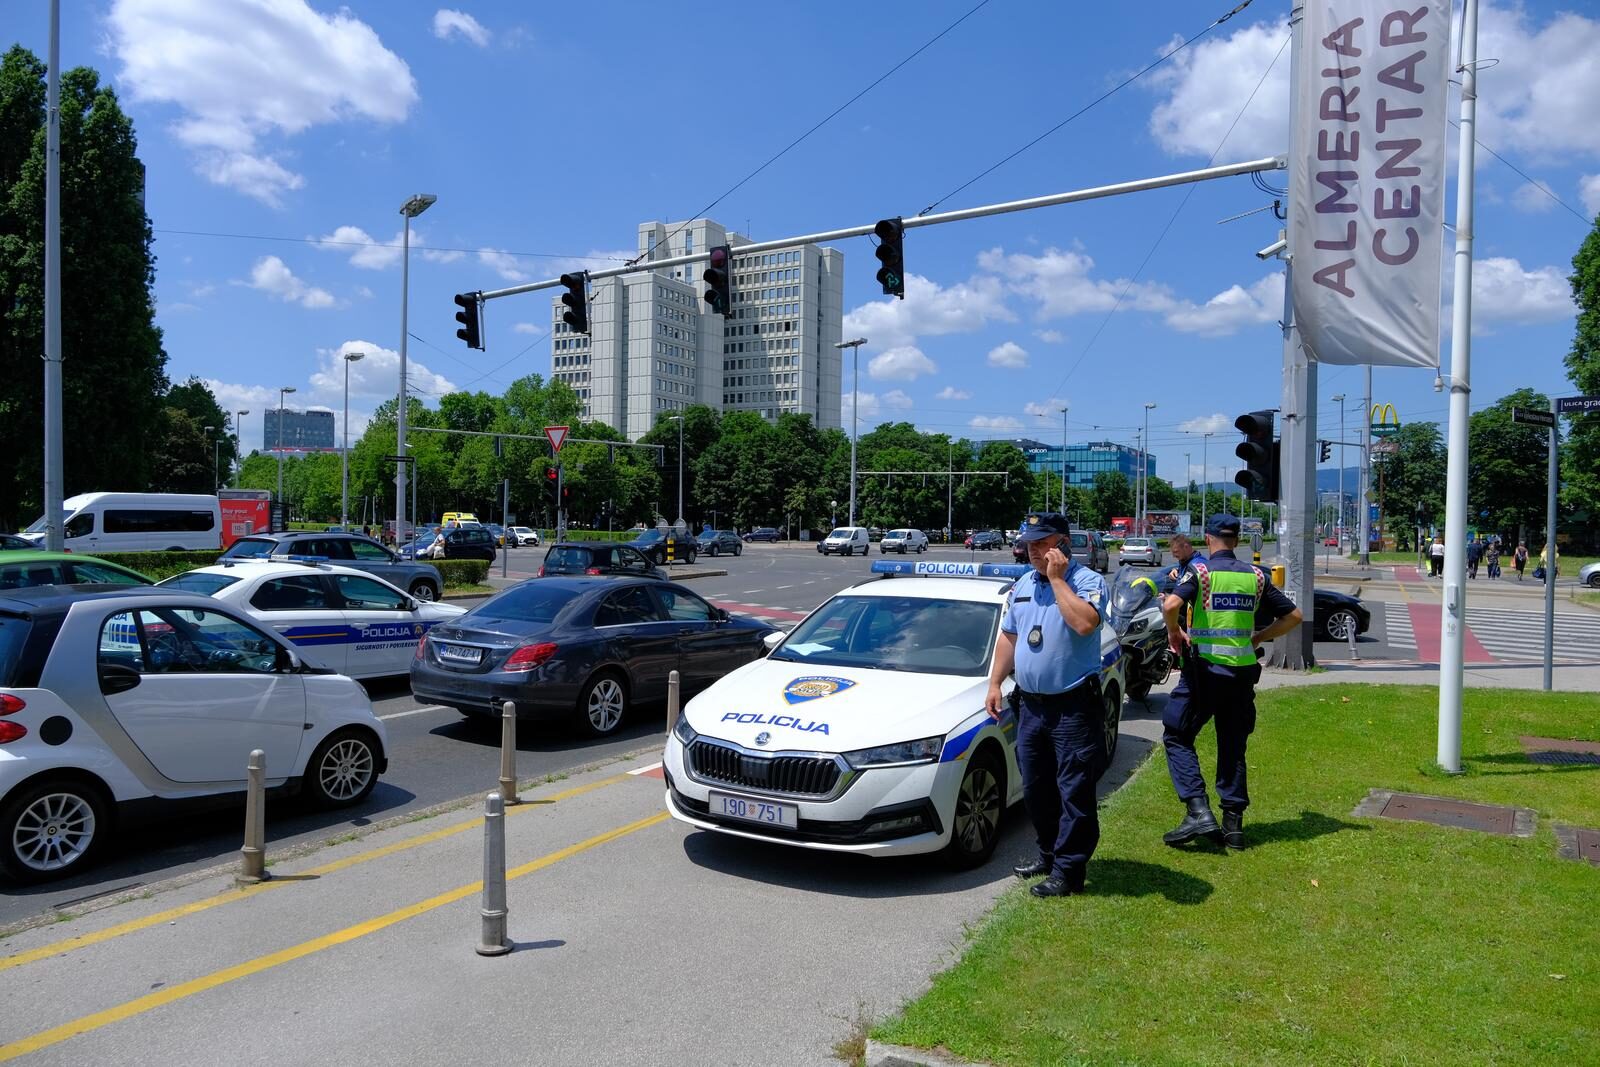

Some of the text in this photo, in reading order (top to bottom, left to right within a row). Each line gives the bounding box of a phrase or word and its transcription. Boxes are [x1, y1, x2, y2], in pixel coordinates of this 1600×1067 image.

[1372, 6, 1429, 266] CENTAR
[1312, 17, 1364, 298] ALMERIA
[918, 563, 975, 575] POLICIJA
[361, 627, 411, 638] POLICIJA
[721, 712, 829, 735] POLICIJA
[723, 797, 782, 823] 190 751
